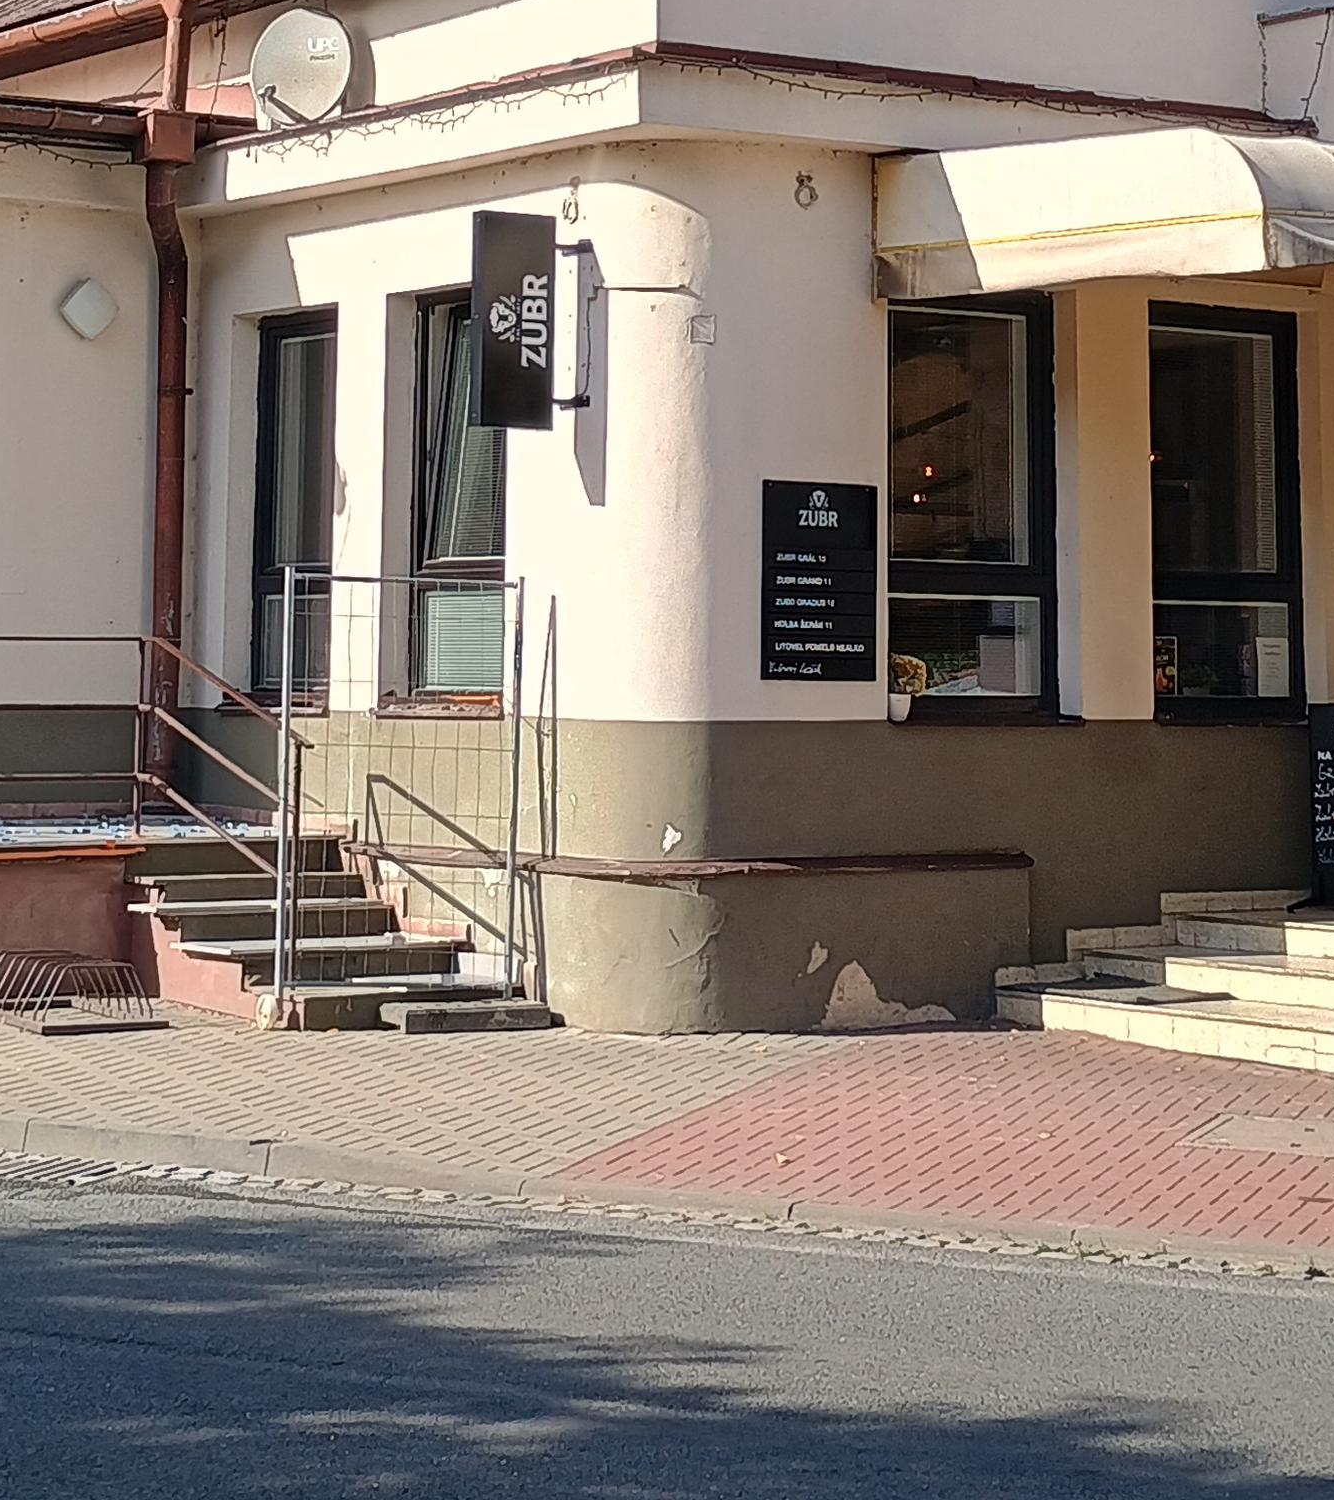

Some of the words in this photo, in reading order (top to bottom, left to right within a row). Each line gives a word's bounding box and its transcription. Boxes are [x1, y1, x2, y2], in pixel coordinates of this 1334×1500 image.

[308, 37, 339, 52] UPC
[521, 274, 548, 369] ZUBR
[798, 510, 838, 528] ZUBR
